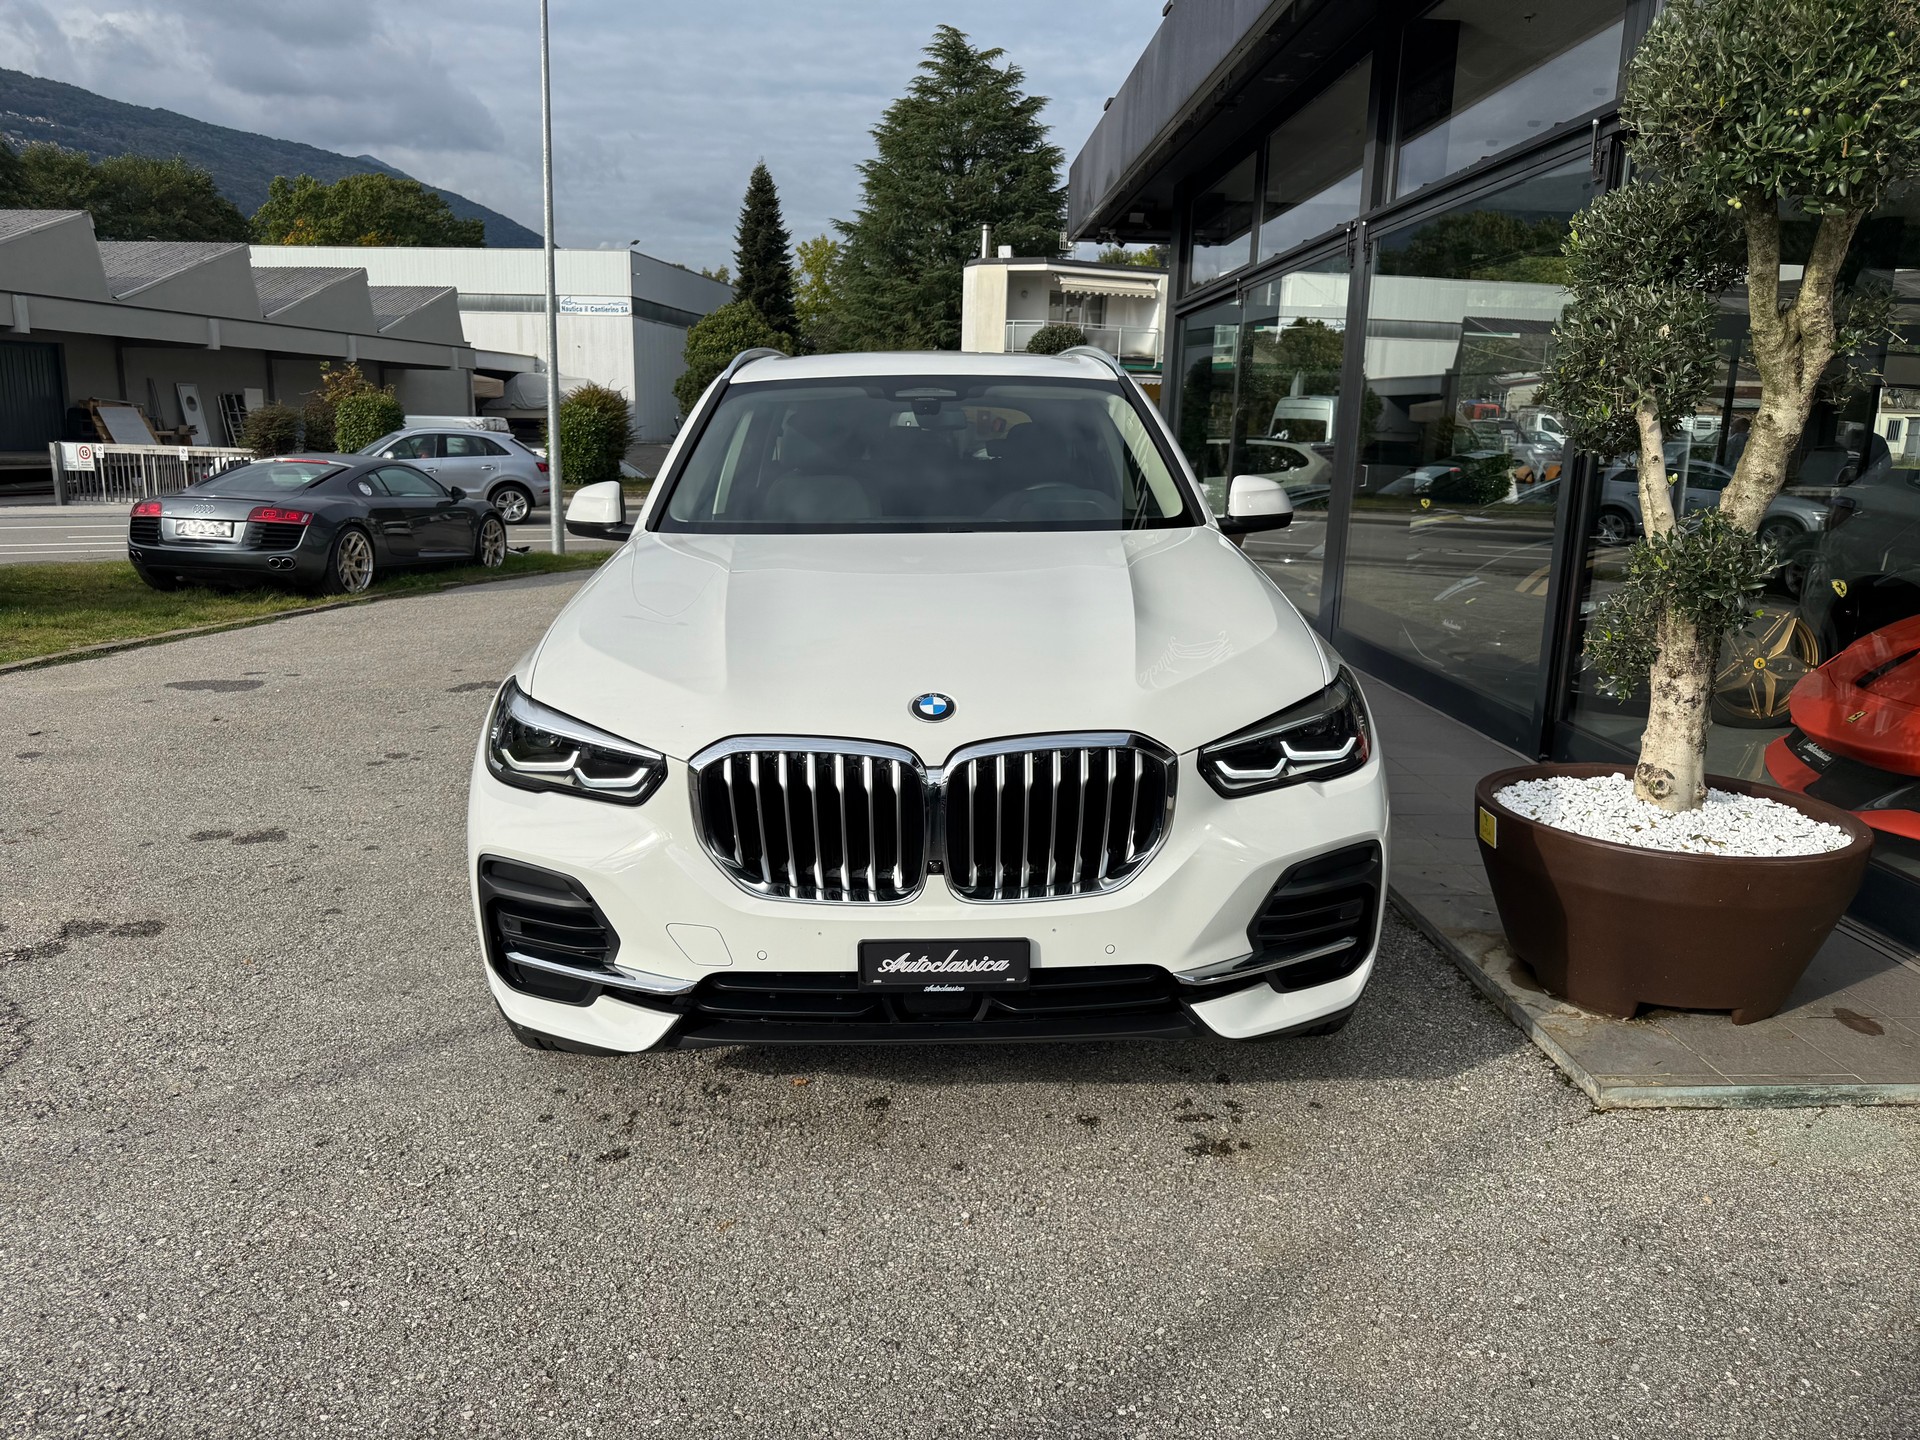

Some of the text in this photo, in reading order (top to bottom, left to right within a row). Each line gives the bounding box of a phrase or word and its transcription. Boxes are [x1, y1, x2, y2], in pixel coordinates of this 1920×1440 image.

[561, 305, 582, 313] Nautica
[81, 449, 88, 457] 15
[877, 949, 1010, 973] Autoclassica
